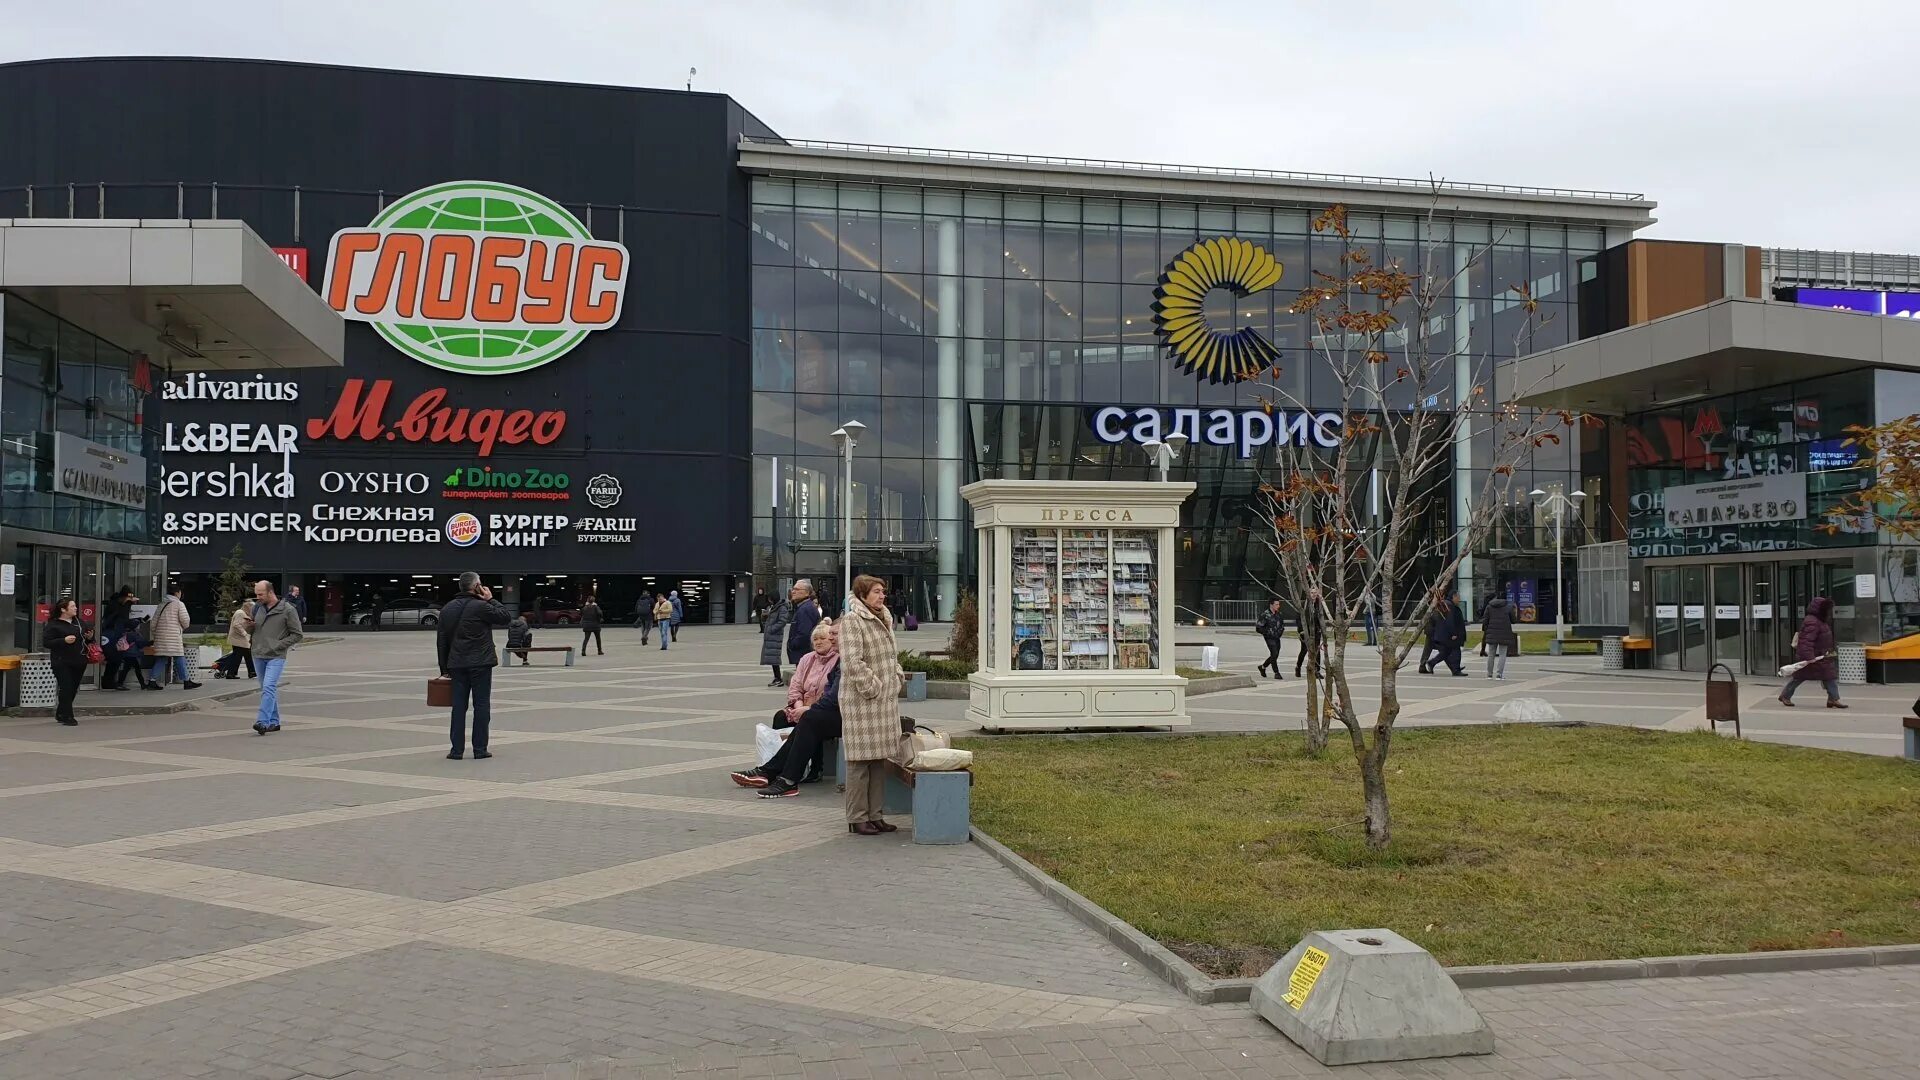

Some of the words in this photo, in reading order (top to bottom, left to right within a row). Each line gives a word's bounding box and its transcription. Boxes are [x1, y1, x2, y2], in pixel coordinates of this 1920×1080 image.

[328, 232, 623, 324] ГЛОБУС
[306, 378, 566, 456] М.видео
[1094, 406, 1343, 459] саларис
[320, 471, 429, 494] OYSHO
[467, 466, 521, 488] Dino
[524, 468, 569, 489] Zoo
[442, 489, 508, 499] гипермаркет
[511, 491, 570, 500] зоотоваров
[312, 504, 434, 522] Снежная
[1041, 508, 1133, 522] ПРЕССА
[450, 519, 477, 530] BURGER
[490, 514, 569, 530] БУРГЕР
[161, 536, 209, 545] LONDON
[304, 525, 441, 543] Королева
[451, 526, 477, 538] KING
[490, 532, 550, 546] КИНГ
[577, 534, 632, 543] БУРГЕРНАЯ
[1304, 949, 1326, 967] РАБОТА
